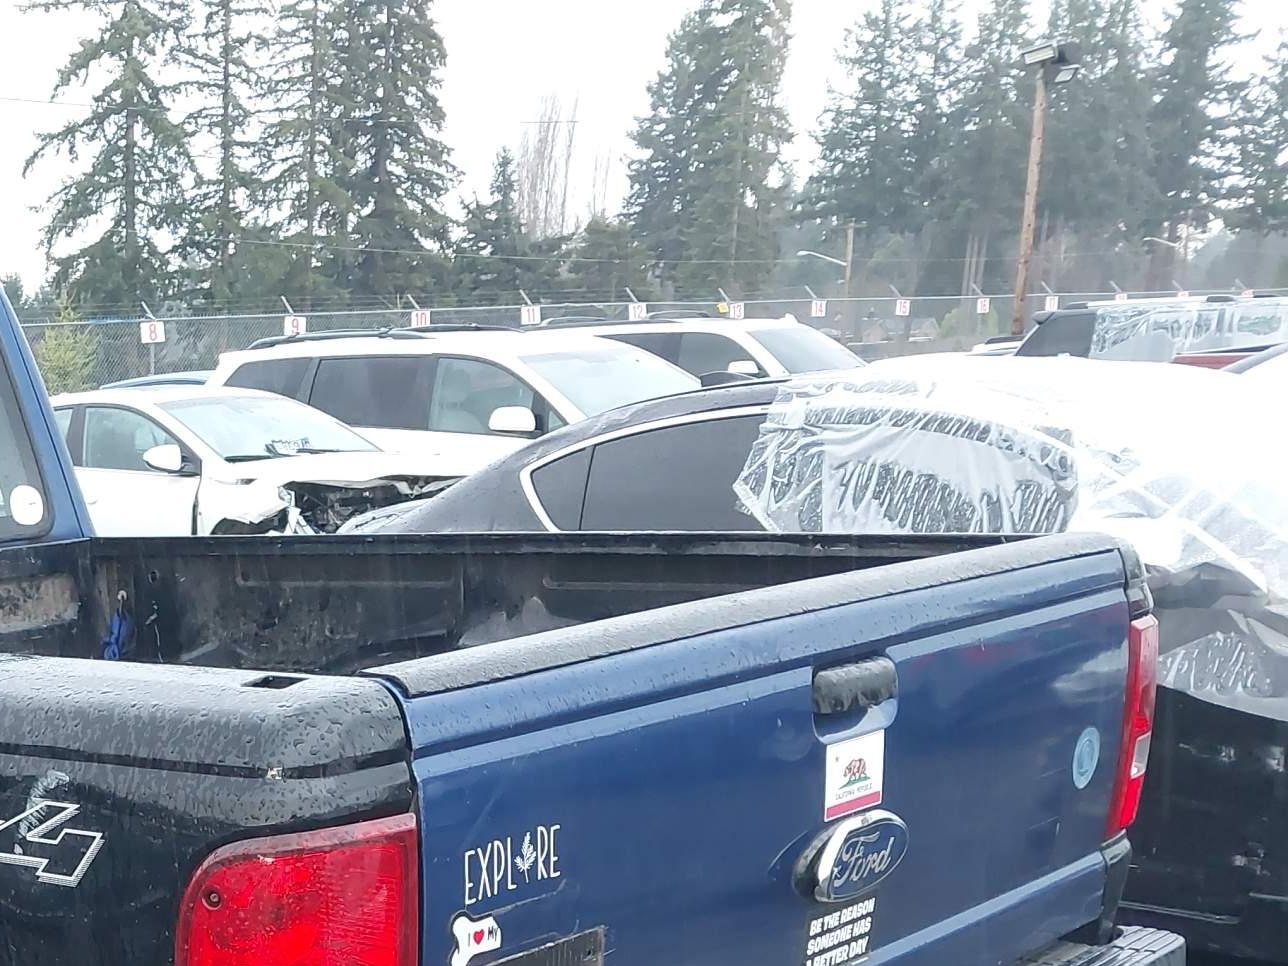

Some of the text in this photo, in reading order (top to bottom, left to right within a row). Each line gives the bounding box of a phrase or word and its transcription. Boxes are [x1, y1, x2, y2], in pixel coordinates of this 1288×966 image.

[527, 307, 536, 322] 11
[631, 304, 643, 319] 12
[732, 304, 743, 318] 13
[814, 303, 824, 314] 14
[897, 302, 907, 314] 15
[291, 318, 299, 333] 9
[415, 312, 427, 327] 10
[149, 323, 158, 341] 8
[464, 825, 561, 905] EXPLRE
[833, 831, 896, 888] Ford
[809, 898, 875, 936] BE THE REASON
[487, 925, 499, 942] My
[806, 916, 872, 955] SOMEONE HAS
[848, 936, 869, 958] DAY
